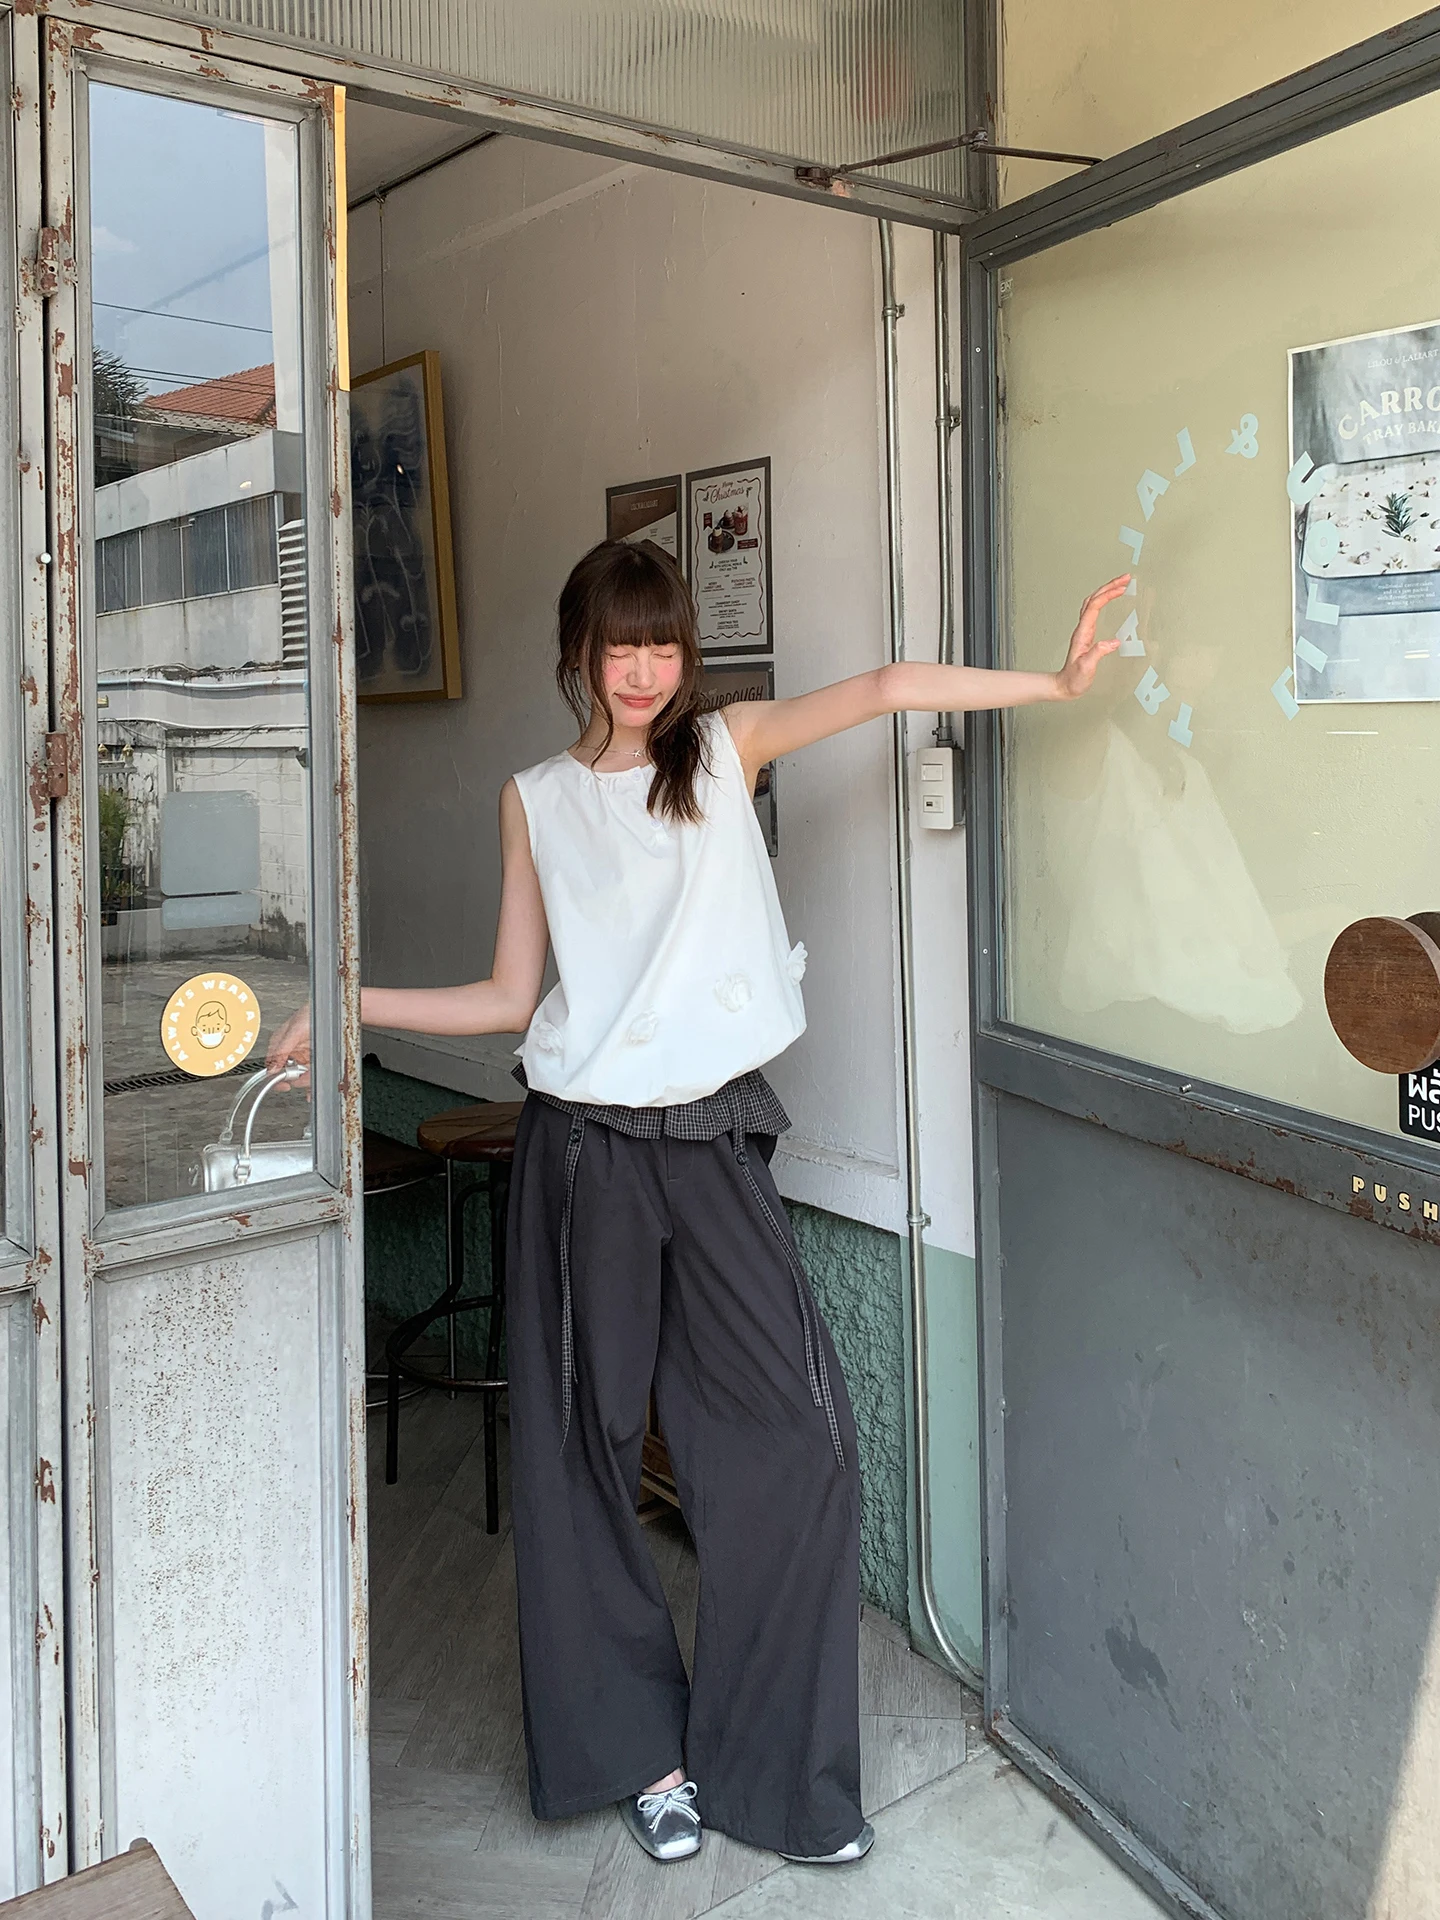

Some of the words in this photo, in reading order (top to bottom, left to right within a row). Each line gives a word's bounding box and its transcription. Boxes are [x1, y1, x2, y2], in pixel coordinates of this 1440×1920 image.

[1367, 358, 1393, 369] LILOU
[1362, 423, 1404, 445] TRAY
[710, 487, 744, 504] Christmas
[702, 685, 764, 708] OURDOUGH
[201, 979, 249, 1004] WEAR
[167, 988, 195, 1062] ALWAYS
[245, 1010, 256, 1021] A
[213, 1030, 254, 1071] MASK
[1352, 1174, 1440, 1223] PUSH
